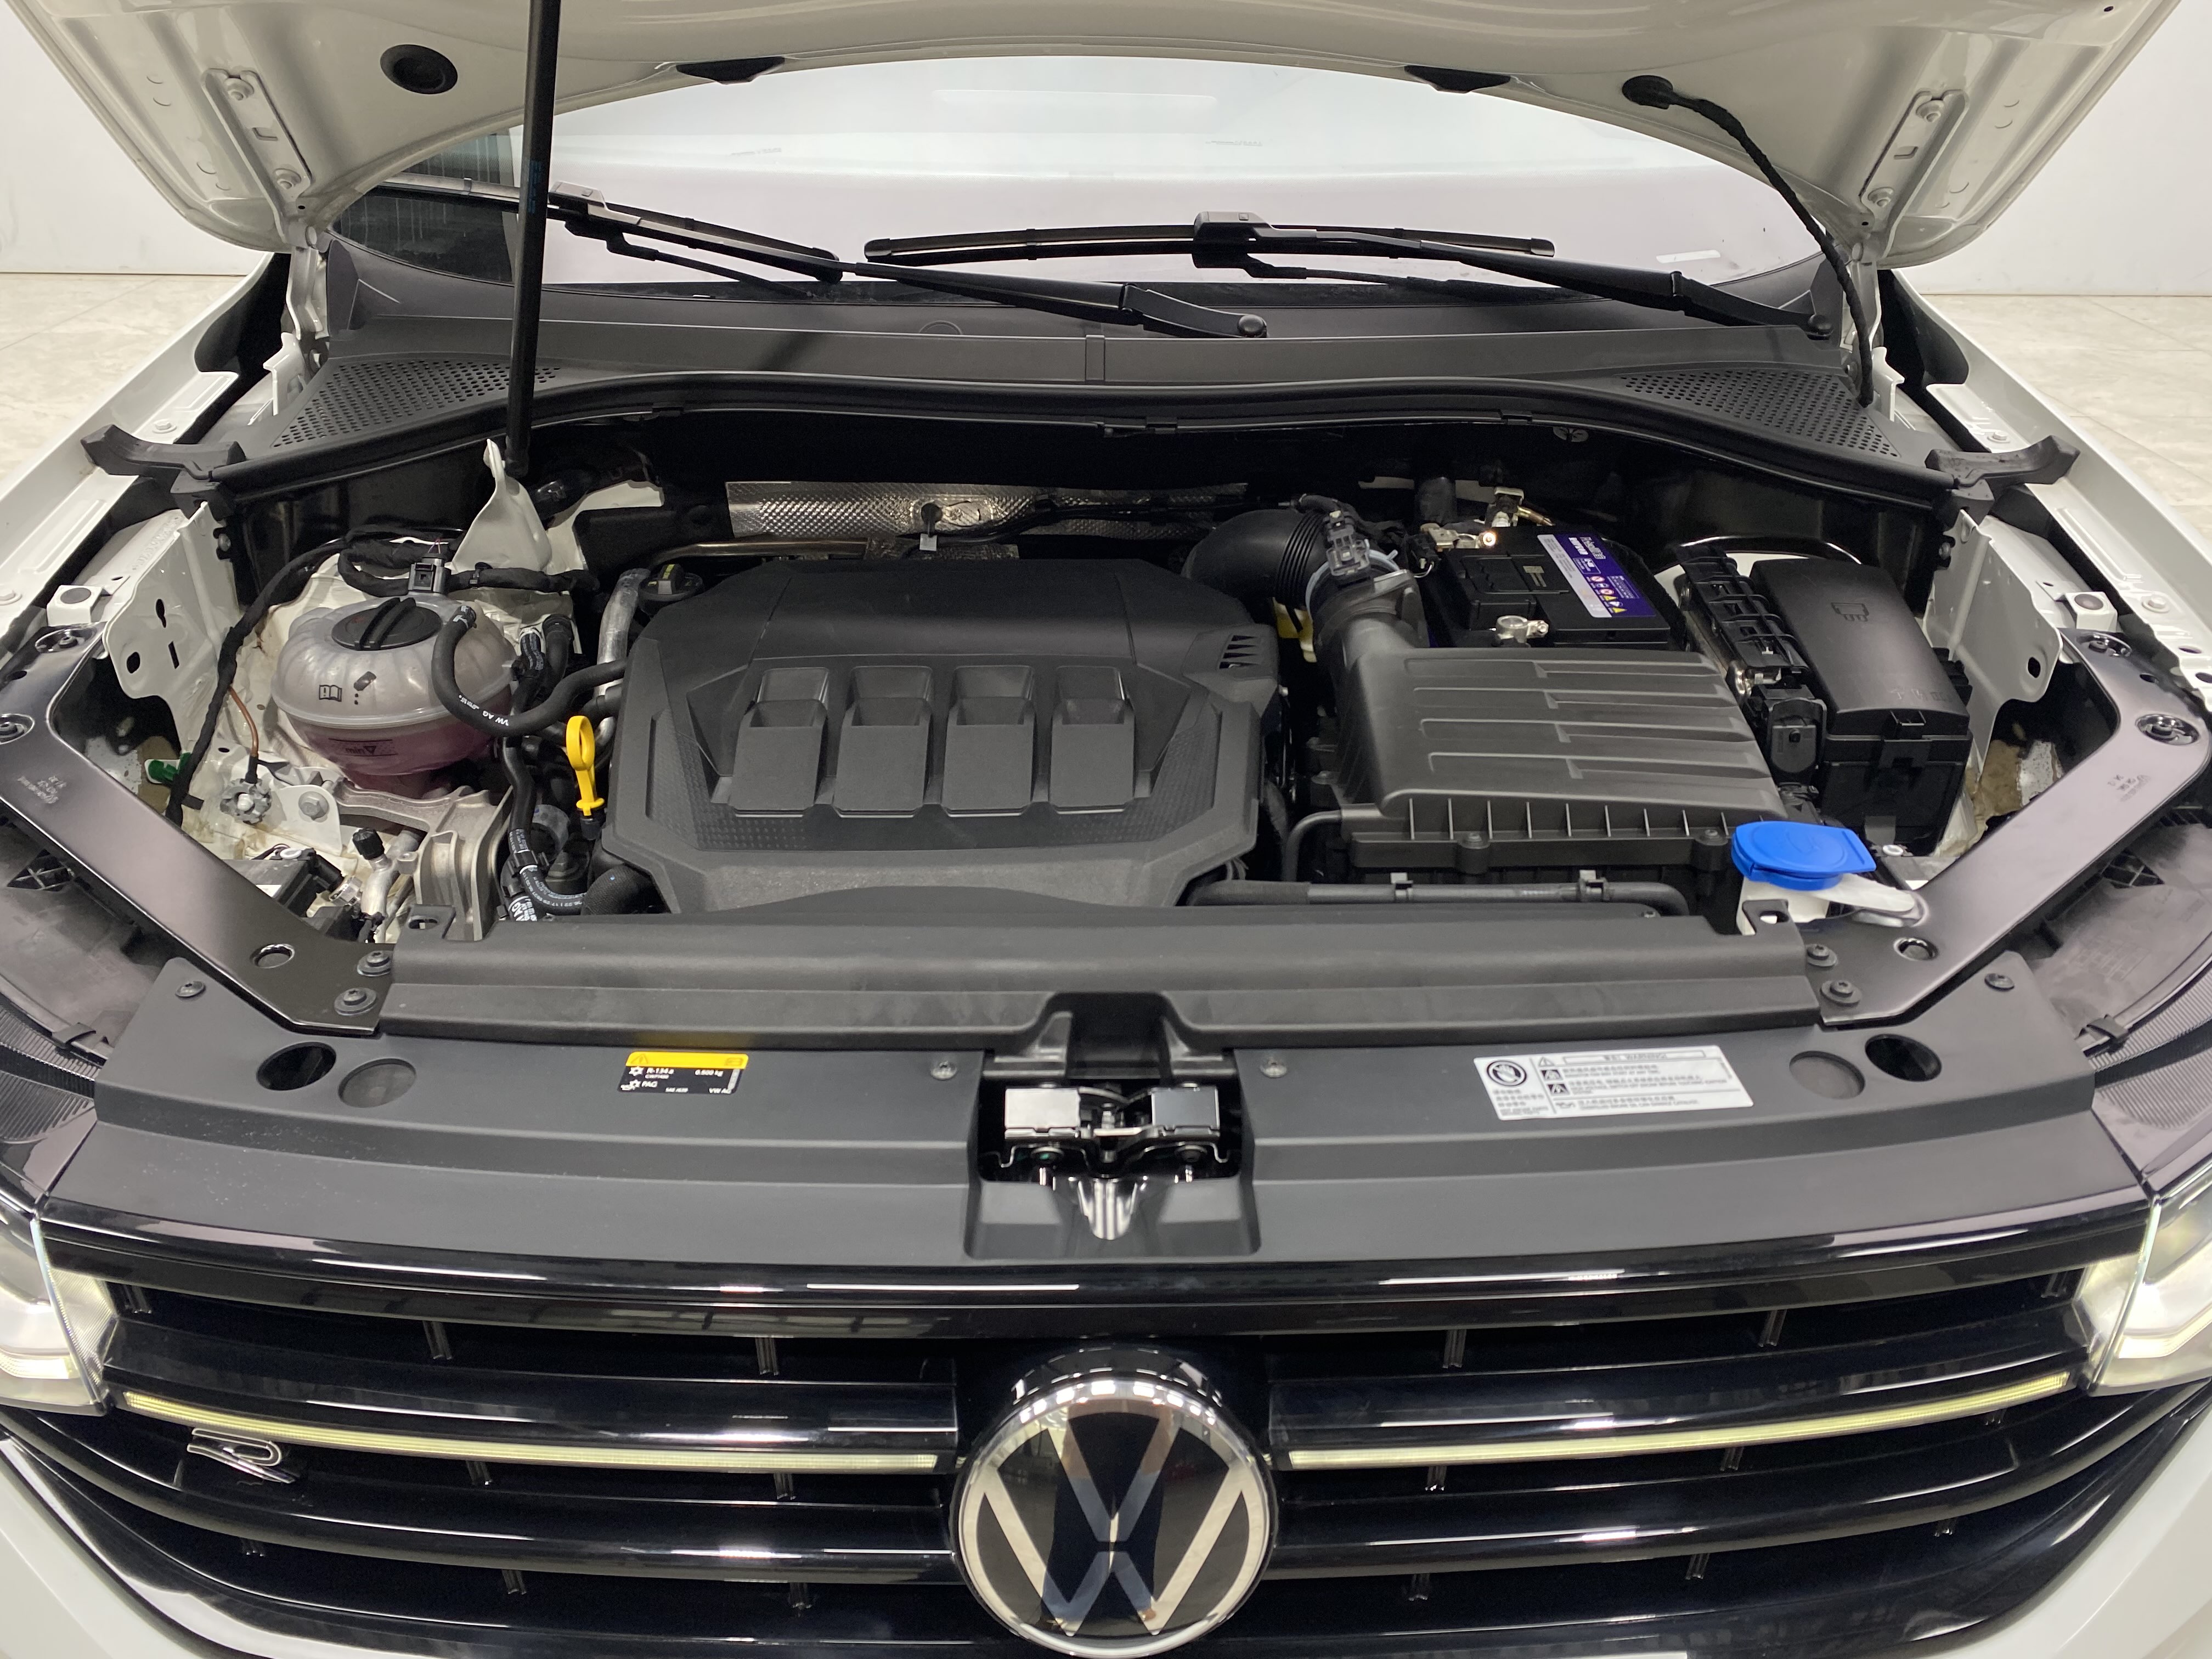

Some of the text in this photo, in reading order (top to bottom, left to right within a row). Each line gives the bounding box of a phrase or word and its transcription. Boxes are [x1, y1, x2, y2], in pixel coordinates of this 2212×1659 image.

[483, 710, 509, 726] VW AG
[345, 747, 365, 755] min
